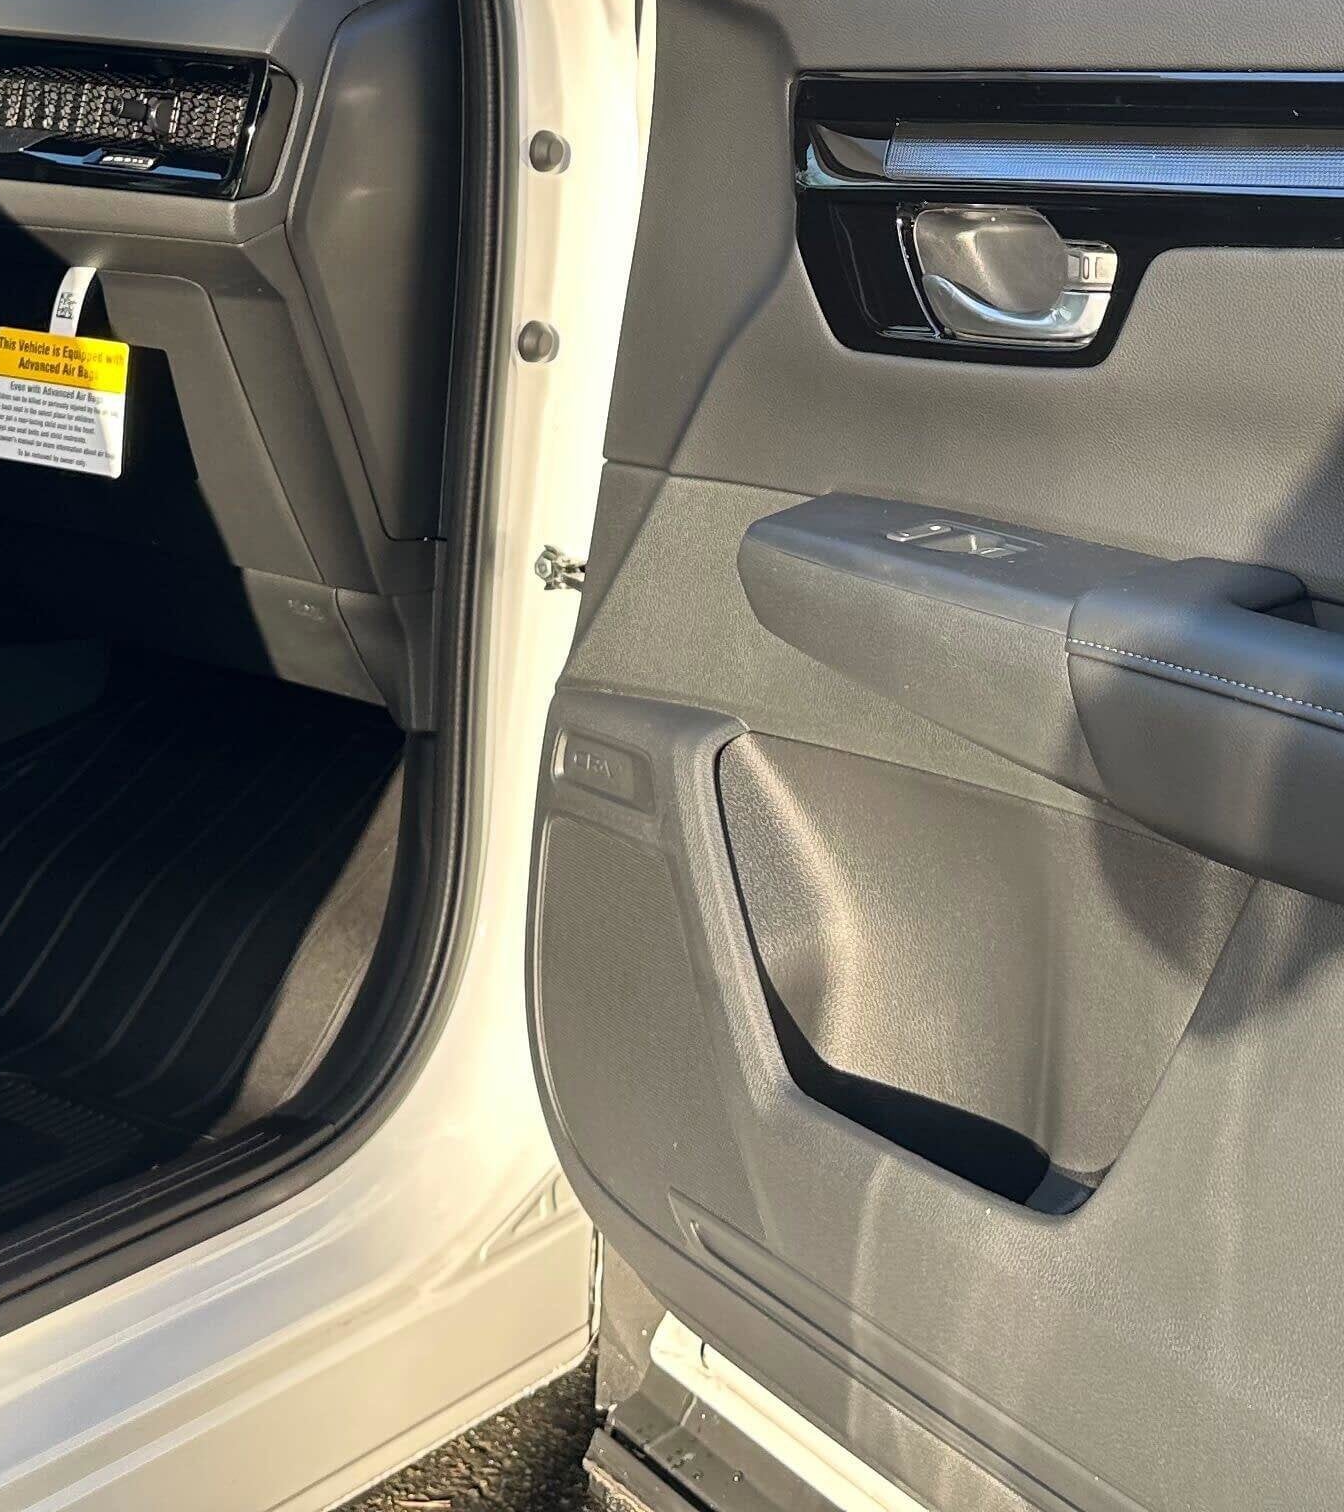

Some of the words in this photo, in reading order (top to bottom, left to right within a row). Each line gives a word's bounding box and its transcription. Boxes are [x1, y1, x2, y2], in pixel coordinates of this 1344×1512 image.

[0, 337, 17, 350] This
[18, 340, 51, 355] Vehicle
[53, 344, 61, 357] is
[19, 358, 61, 374] Advanced
[63, 364, 76, 377] Air
